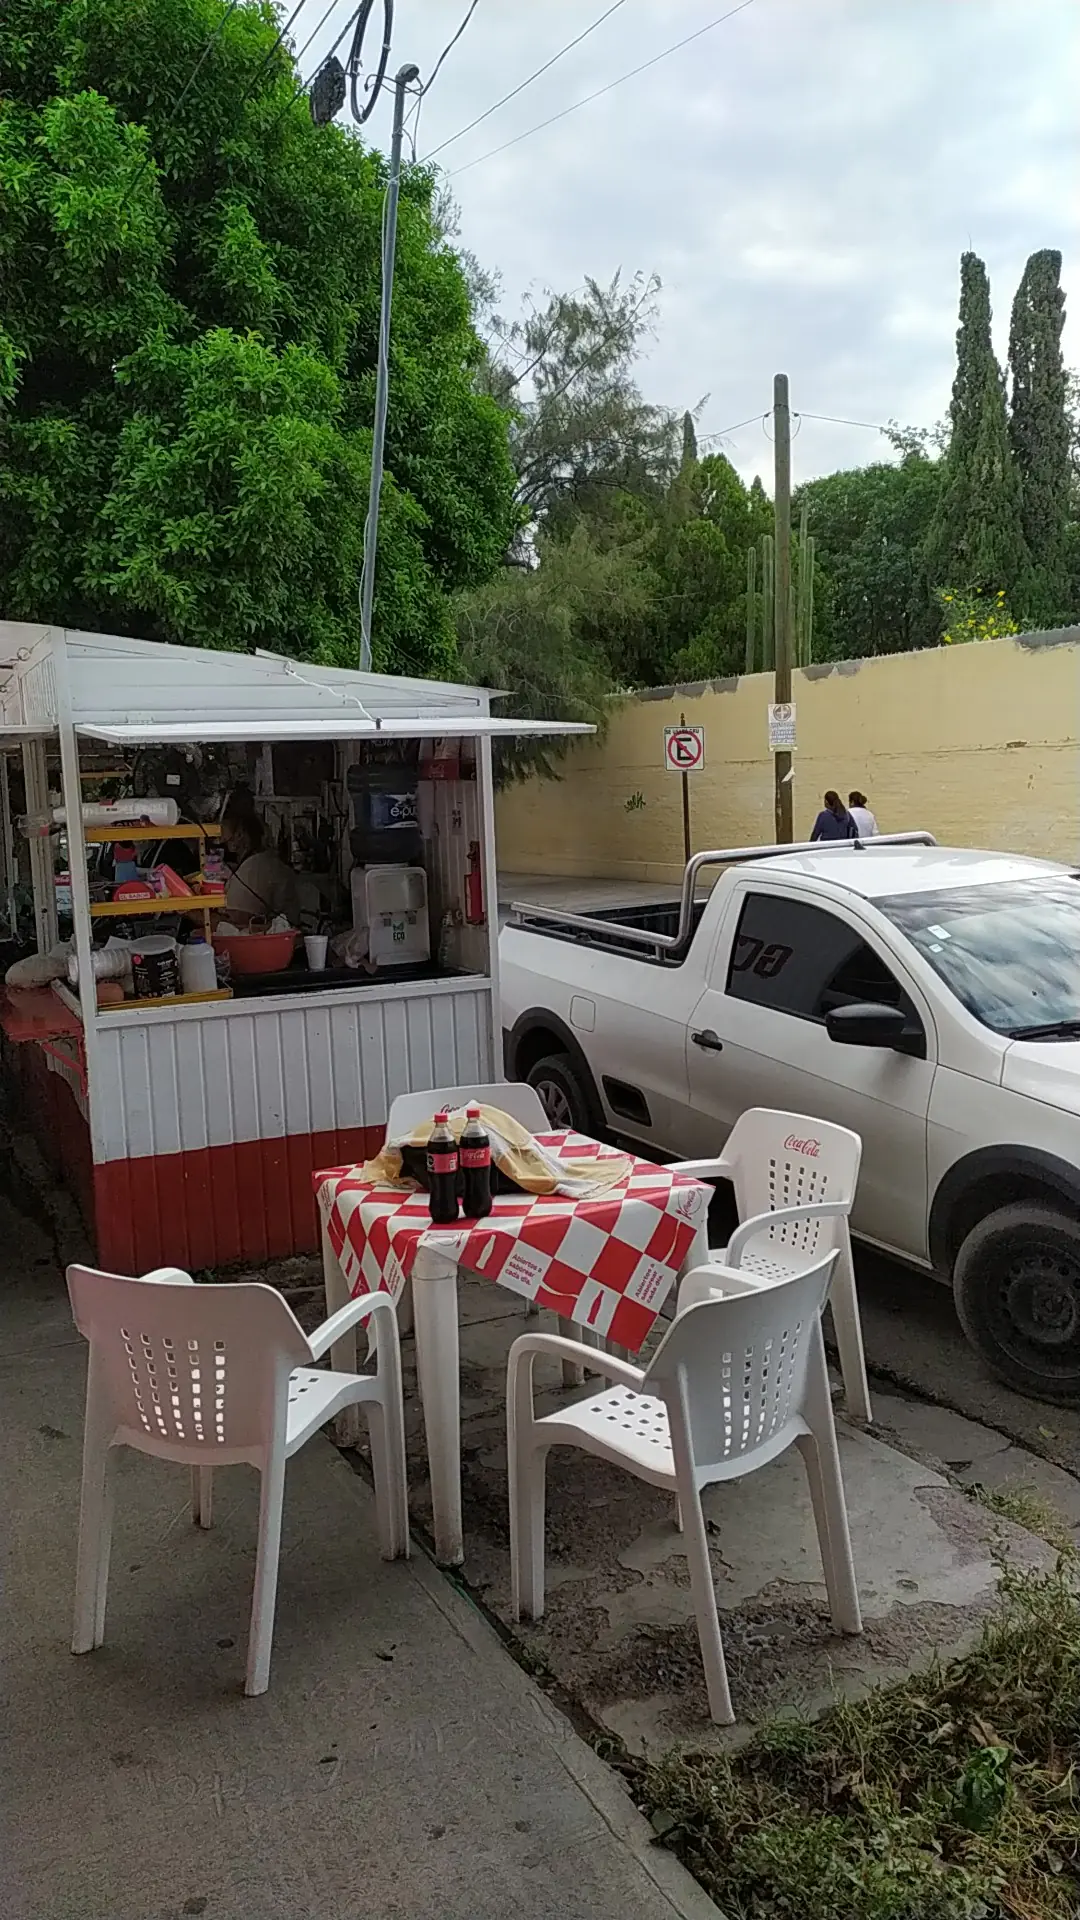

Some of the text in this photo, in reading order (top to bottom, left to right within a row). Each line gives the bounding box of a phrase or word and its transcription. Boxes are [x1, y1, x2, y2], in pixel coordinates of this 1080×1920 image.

[393, 931, 405, 940] ECO
[504, 1268, 520, 1279] cada
[508, 1261, 535, 1277] saborear
[640, 1270, 658, 1301] saborear
[646, 1287, 657, 1304] cada
